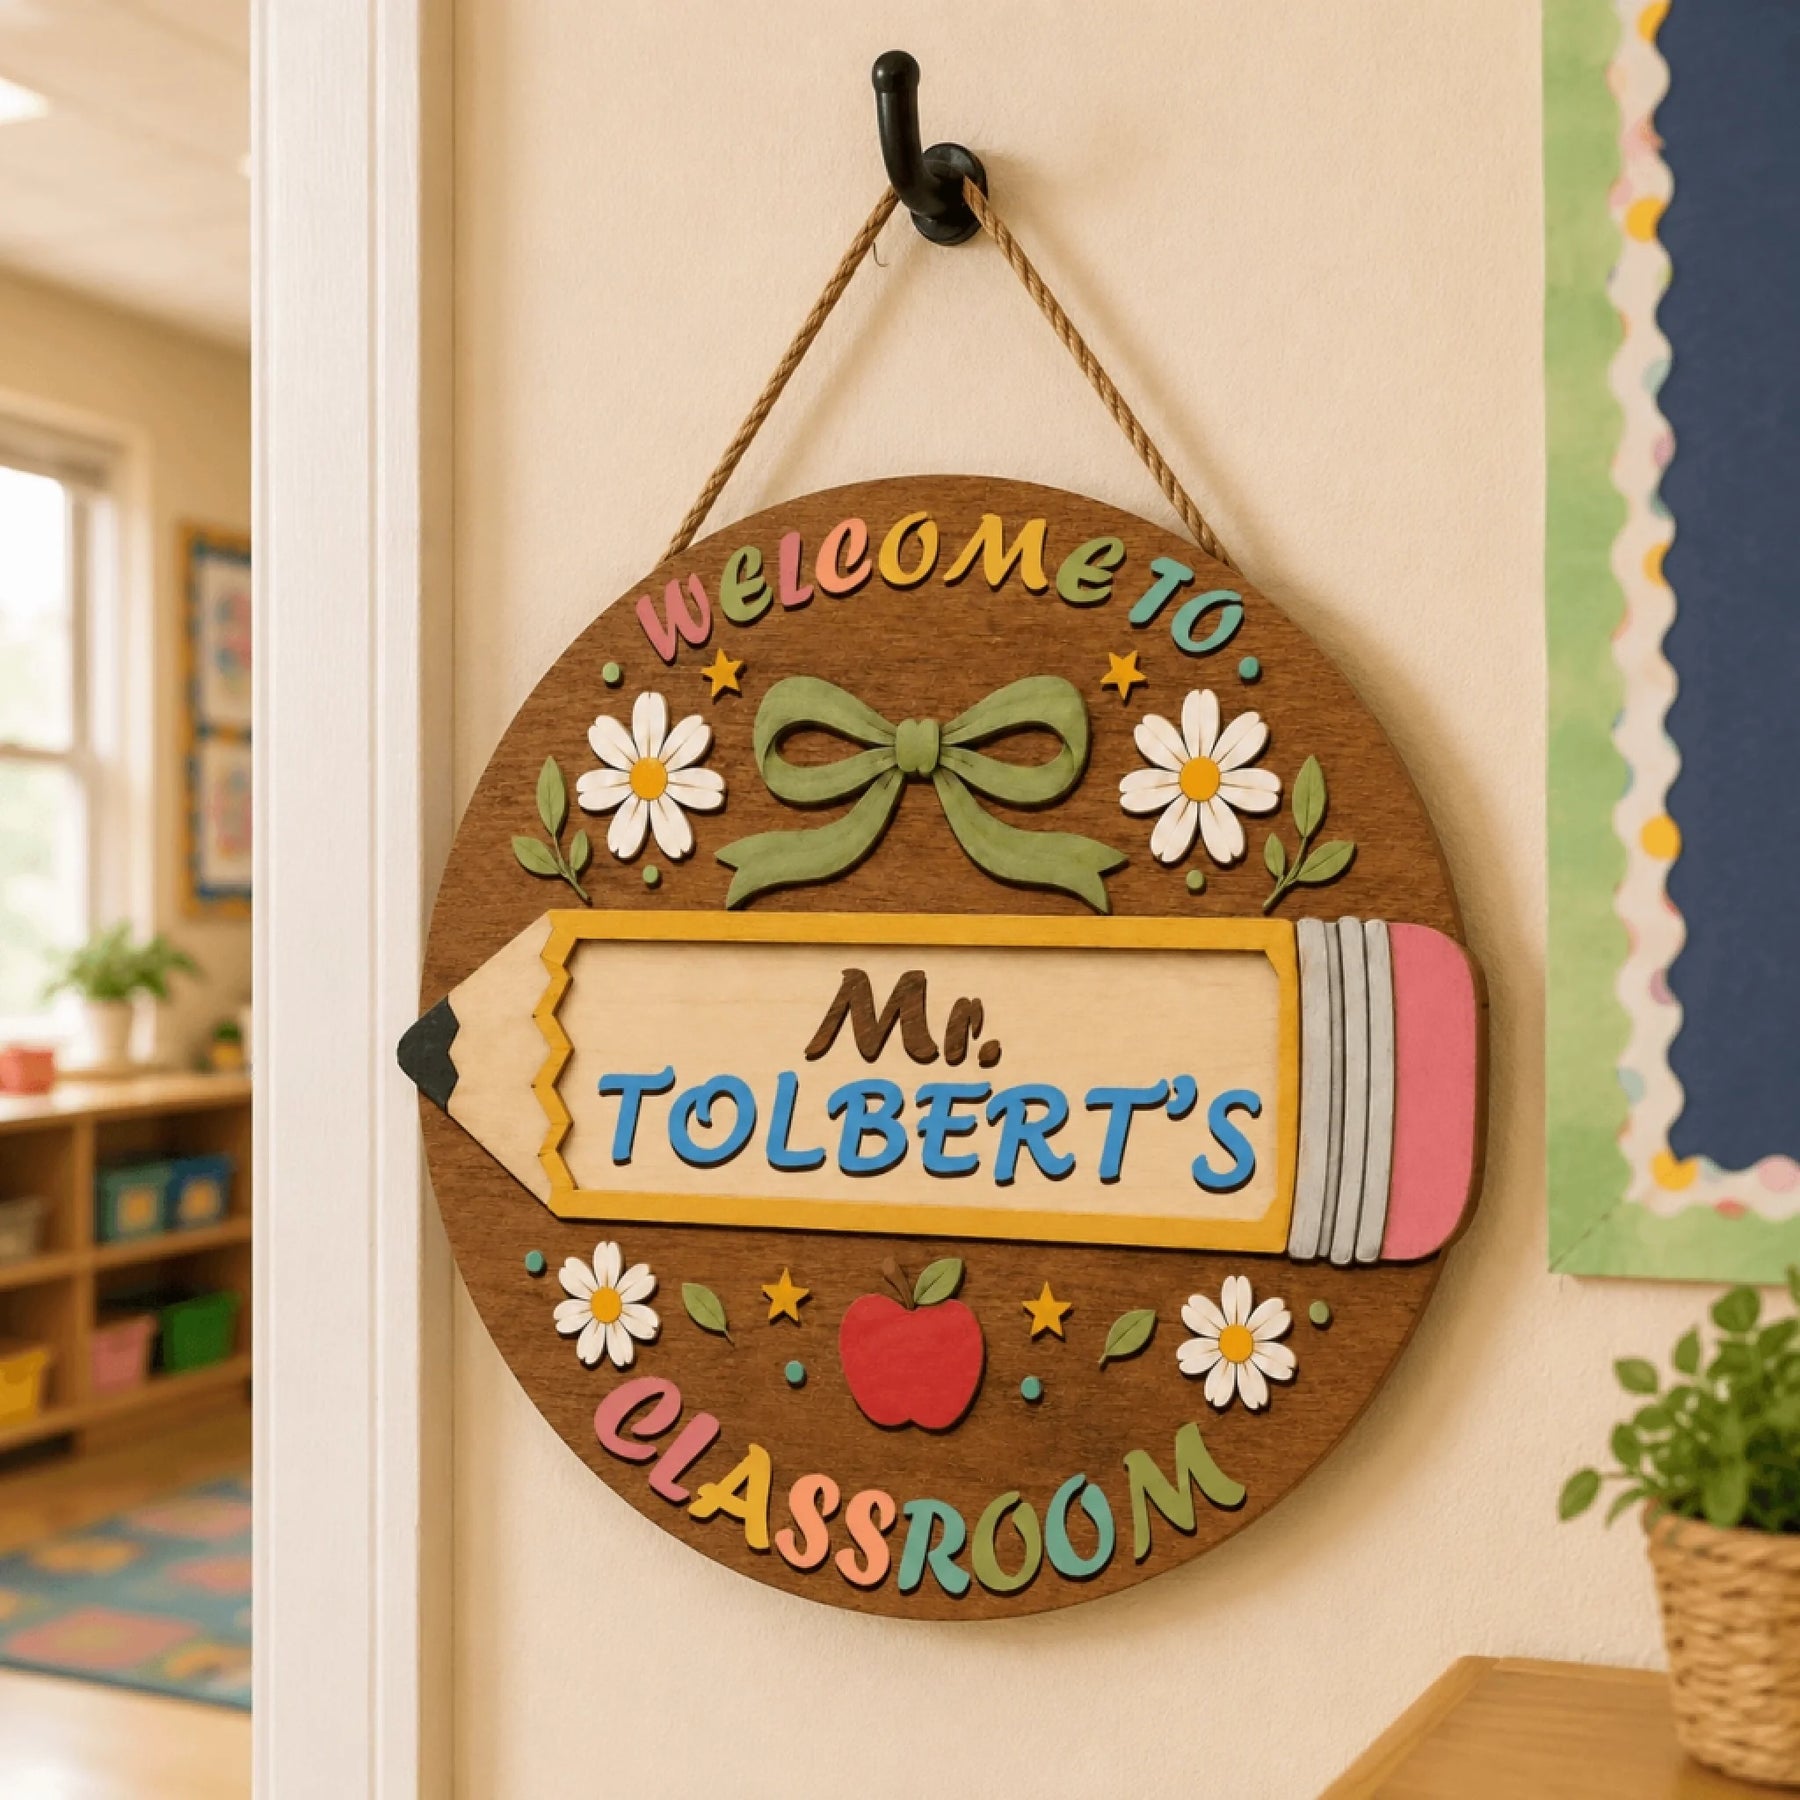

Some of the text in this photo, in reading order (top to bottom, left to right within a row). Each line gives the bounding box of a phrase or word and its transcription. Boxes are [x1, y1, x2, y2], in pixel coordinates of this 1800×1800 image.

[635, 511, 1245, 663] WELCOME TO
[804, 968, 1002, 1067] Mr.
[597, 1065, 1263, 1193] TOLBERT'S
[594, 1376, 1247, 1595] CLASSROOM
